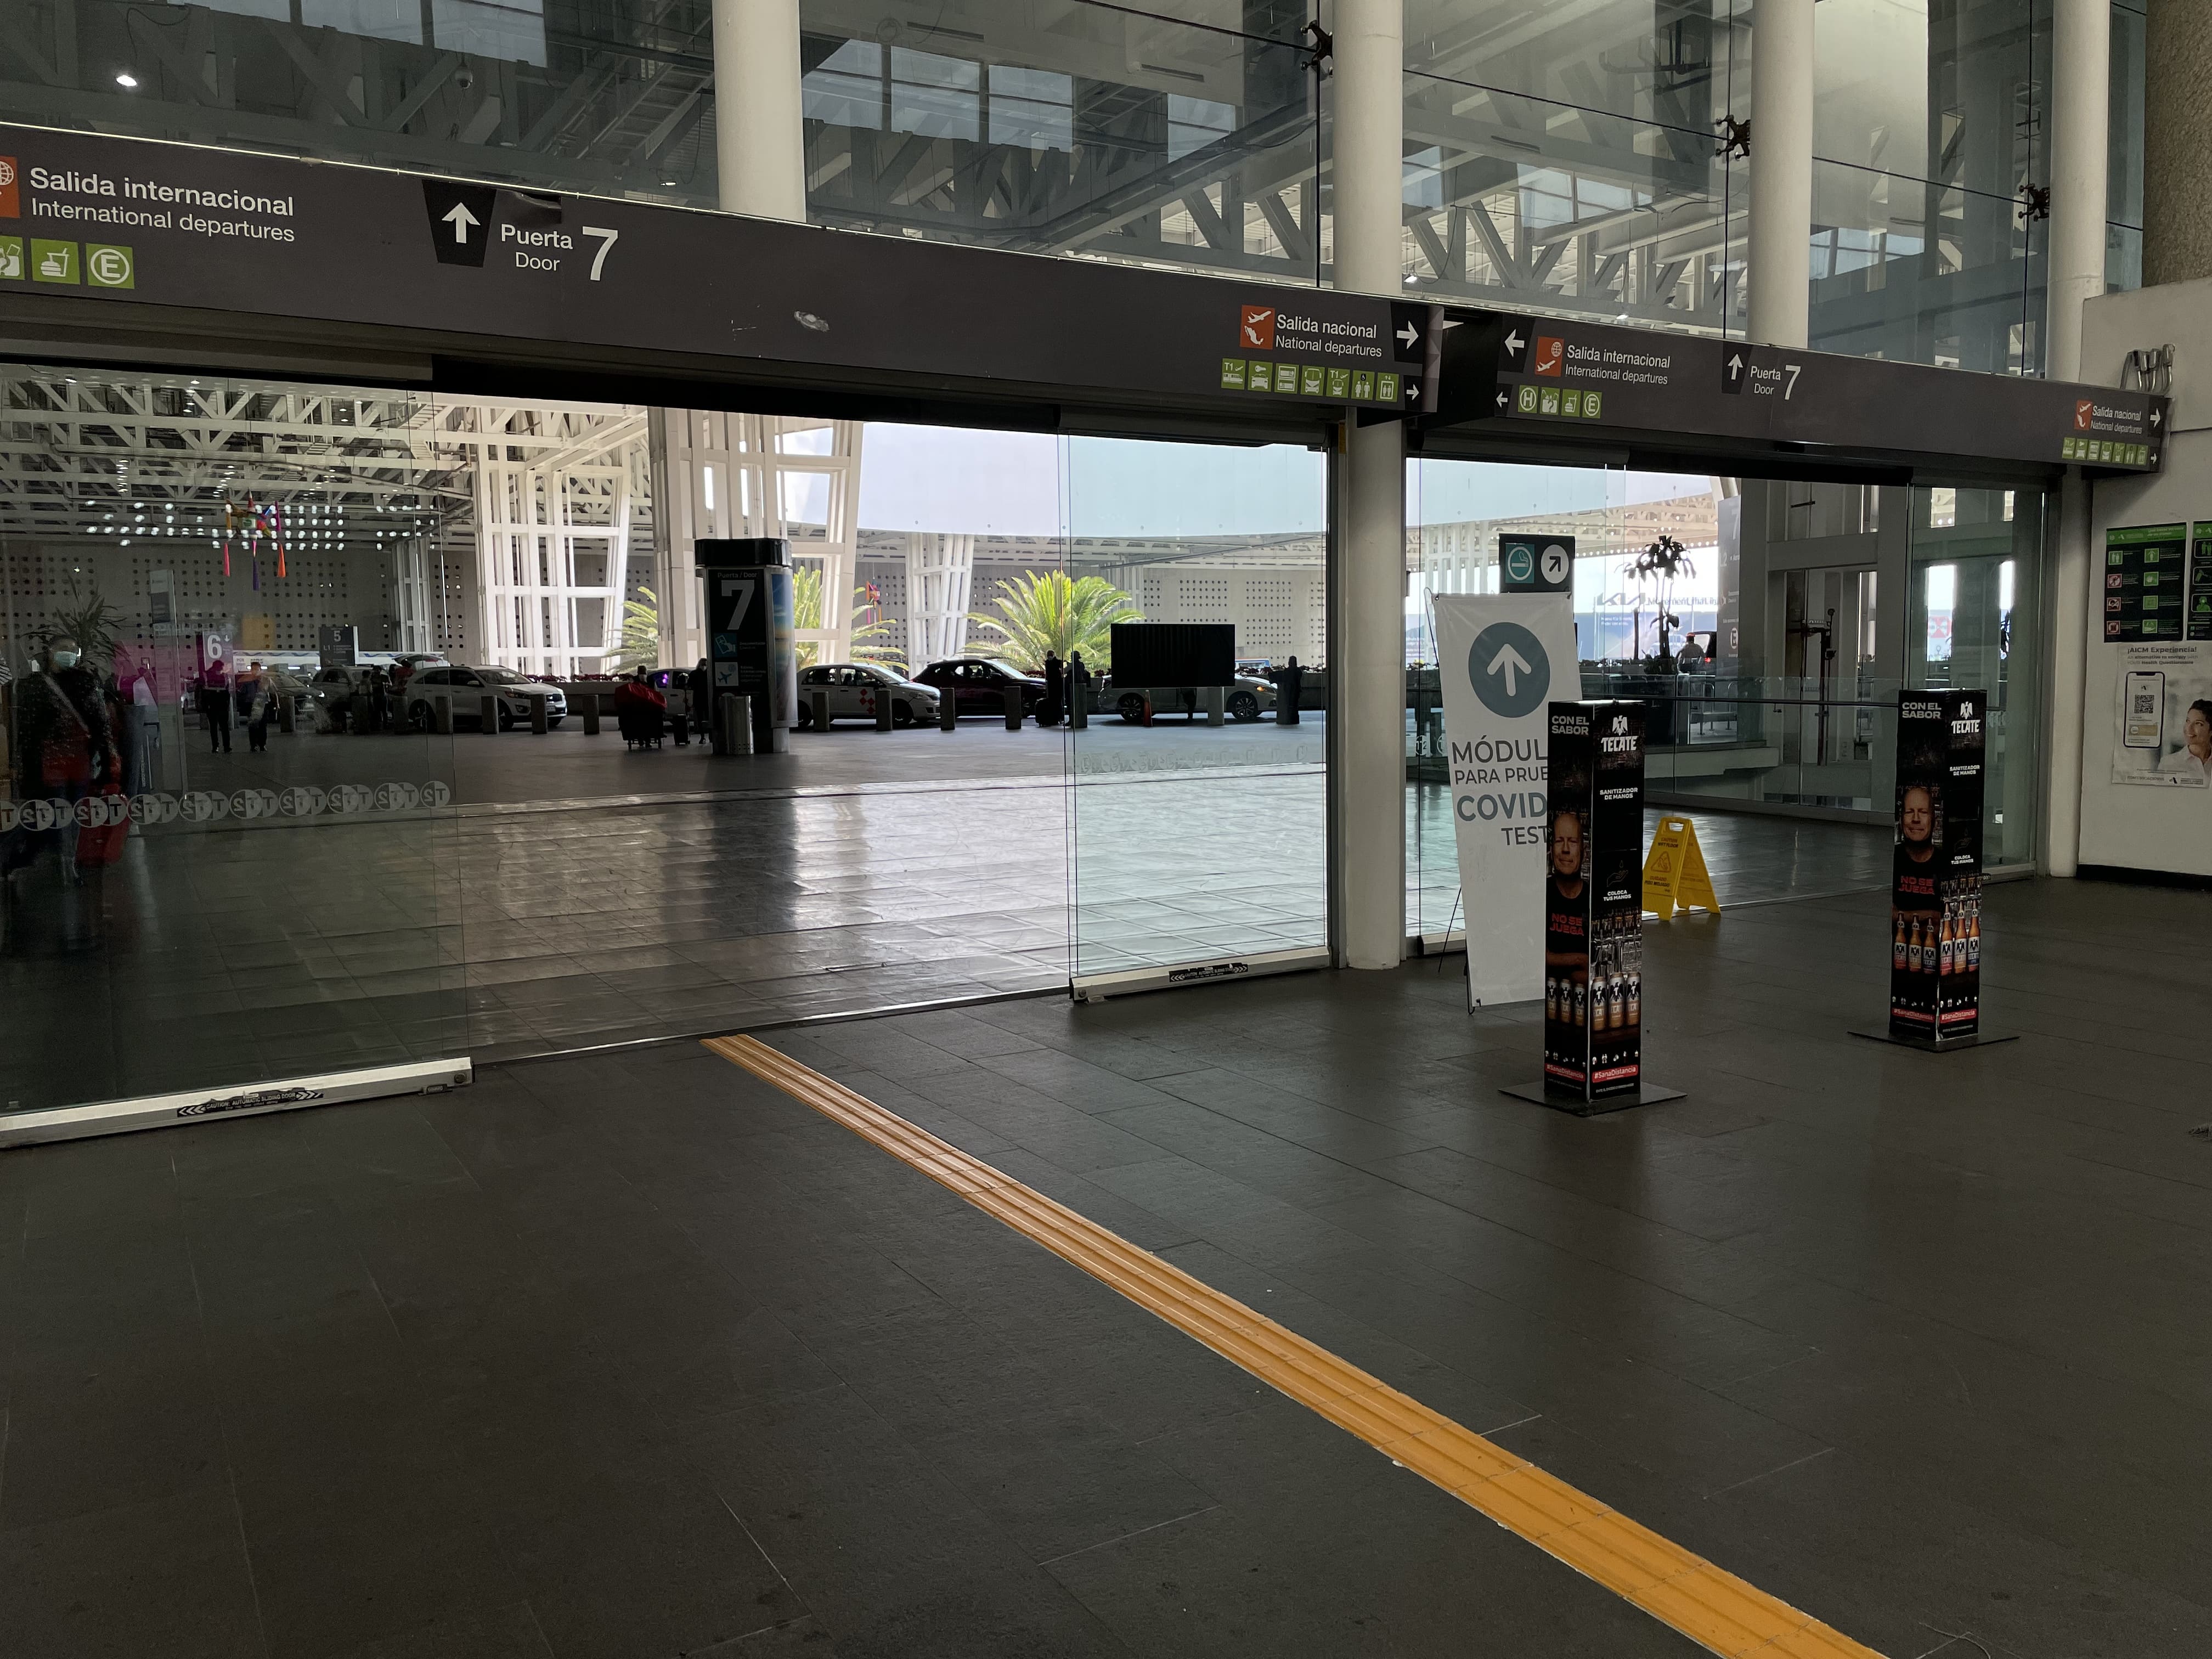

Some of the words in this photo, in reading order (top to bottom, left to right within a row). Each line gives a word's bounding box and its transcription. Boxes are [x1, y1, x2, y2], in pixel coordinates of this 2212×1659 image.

[30, 167, 115, 197] Salida
[125, 177, 294, 216] internacional
[32, 198, 171, 228] International
[179, 214, 295, 242] departures
[501, 223, 573, 250] Puerta
[582, 226, 618, 281] 7
[516, 251, 560, 271] Door
[1277, 314, 1318, 333] Salida
[1322, 321, 1376, 338] nacional
[1276, 335, 1322, 351] National
[1325, 340, 1382, 357] departures
[1567, 345, 1600, 362] Salida
[1603, 348, 1670, 369] internacional
[1224, 362, 1233, 371] T1
[1330, 370, 1339, 379] T1
[1565, 364, 1620, 381] International
[1622, 369, 1668, 385] departures
[1750, 366, 1781, 381] Puerta
[1785, 365, 1801, 400] 7
[1754, 383, 1774, 395] Door
[2092, 405, 2112, 417] Salida
[2114, 410, 2142, 421] nacional
[2091, 420, 2113, 431] National
[2114, 423, 2142, 434] departures
[721, 580, 755, 630] 7
[334, 630, 341, 642] 5
[207, 634, 222, 658] 6
[1551, 715, 1575, 725] CON
[1576, 716, 1589, 725] EL
[1902, 711, 1940, 719] SABOR
[1551, 725, 1589, 735] SABOR
[1951, 719, 1980, 734] TECATE
[1452, 735, 1548, 764] MÓDUL
[1601, 736, 1639, 752] TECATE
[1455, 769, 1500, 785] PARA
[1505, 767, 1548, 783] PRUE
[1457, 792, 1547, 821] COVID
[1901, 875, 1916, 884] NO
[1918, 878, 1934, 886] SE
[1898, 884, 1936, 895] JUEGA
[1552, 913, 1567, 923] NO
[1568, 916, 1583, 926] SE
[1549, 922, 1584, 936] JUEGA
[1547, 1064, 1584, 1079] #SanaDistancia
[1594, 1066, 1637, 1079] #SanaDistancia
